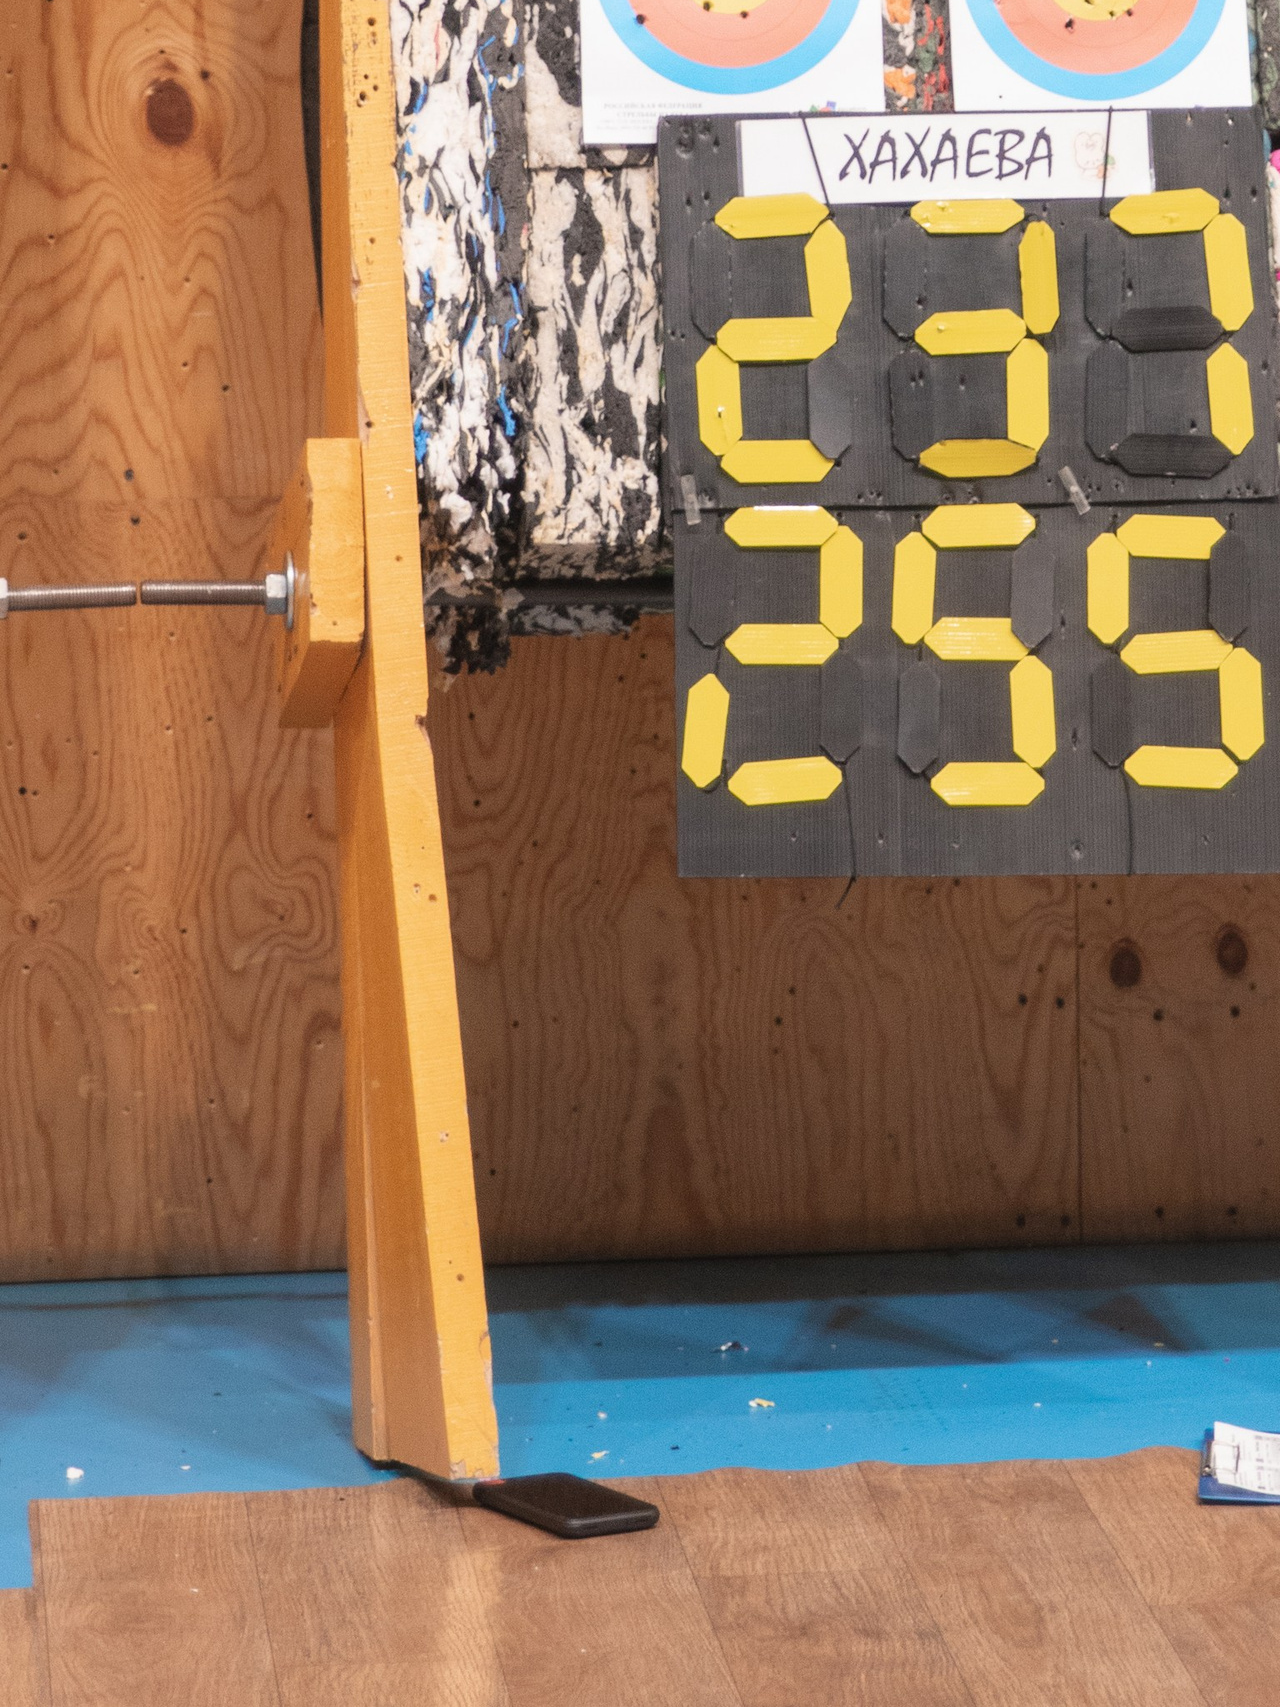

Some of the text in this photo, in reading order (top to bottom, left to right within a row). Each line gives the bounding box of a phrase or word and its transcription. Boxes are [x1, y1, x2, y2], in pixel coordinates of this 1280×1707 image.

[839, 126, 1053, 184] ХАХАЕВА
[696, 188, 1255, 484] 237
[681, 502, 1266, 807] 255
